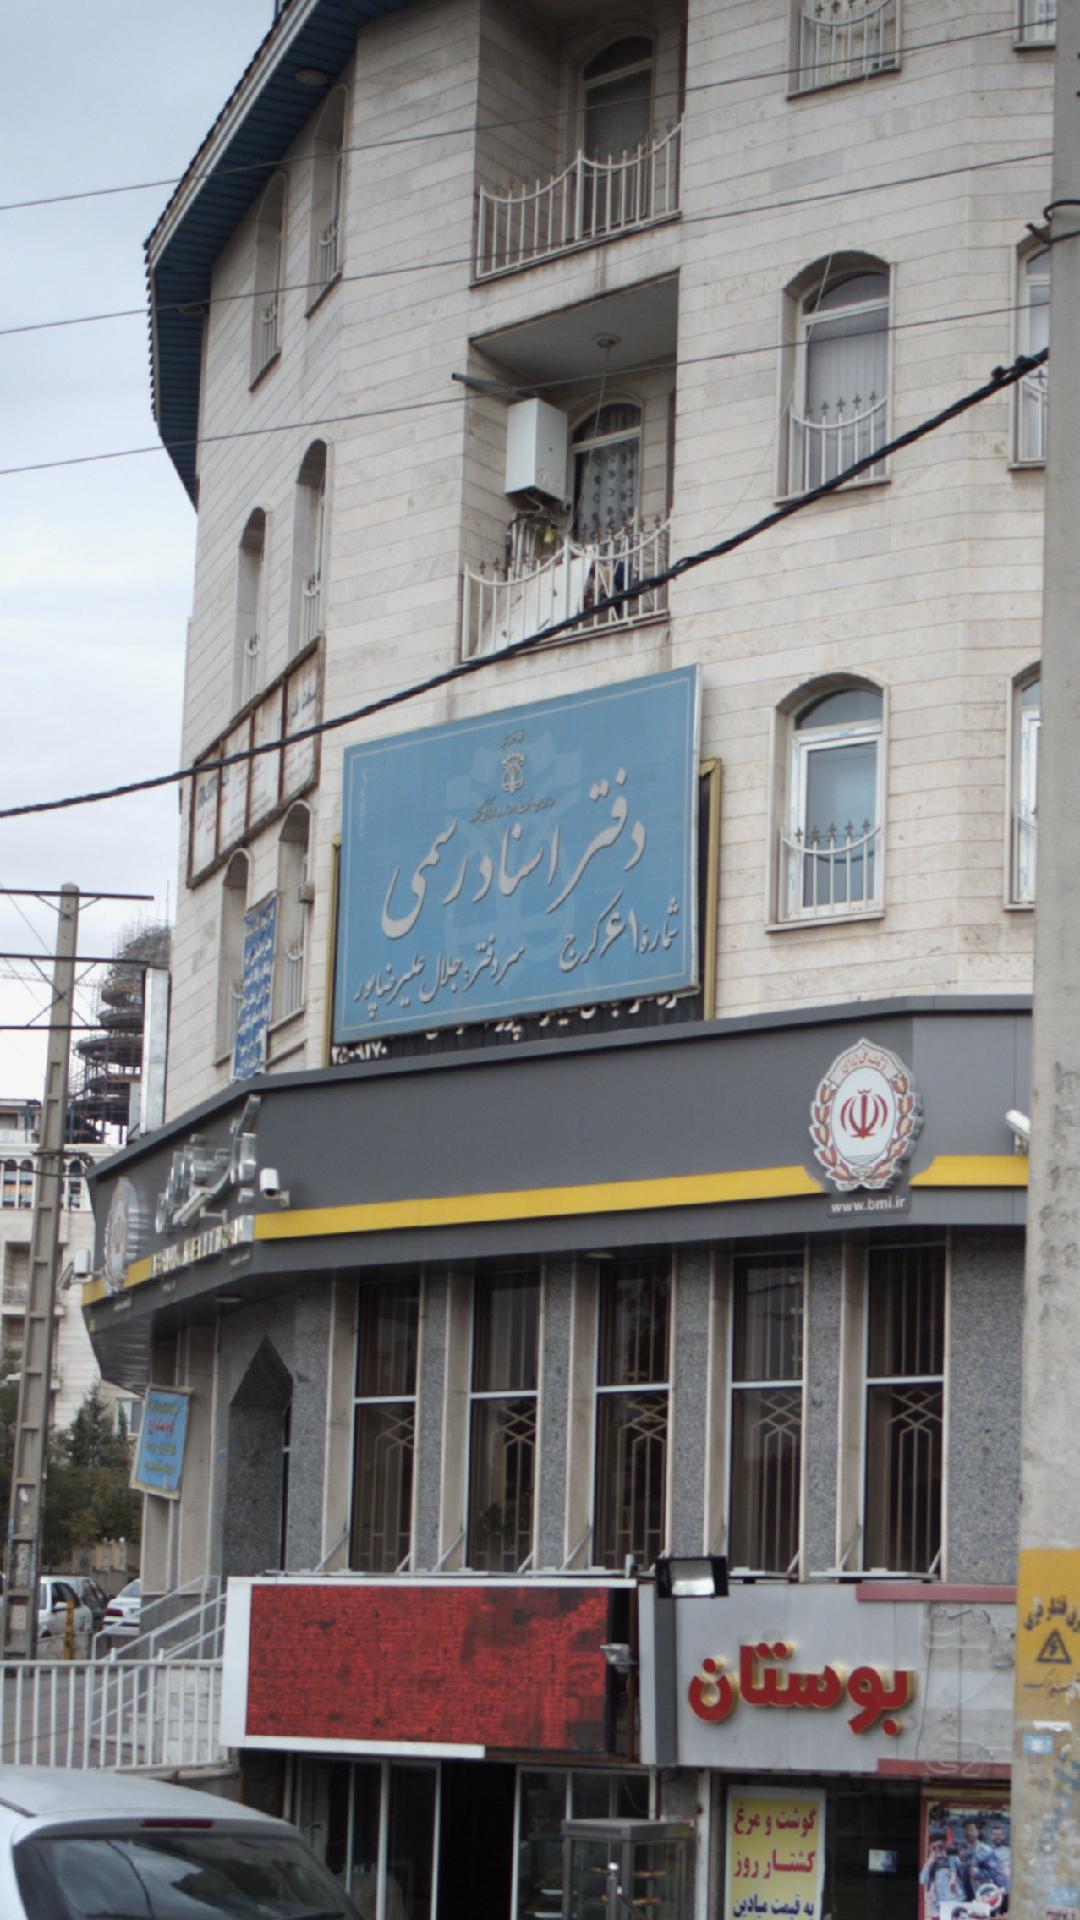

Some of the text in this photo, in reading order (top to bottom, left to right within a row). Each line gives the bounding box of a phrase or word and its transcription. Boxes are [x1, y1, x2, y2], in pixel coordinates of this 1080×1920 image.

[381, 767, 647, 941] دفتر اسناد رسمی
[419, 952, 464, 1004] جلال
[831, 1195, 906, 1213] www.bmi.ir
[687, 1642, 913, 1736] بوستان
[733, 1802, 818, 1838] گوشت و مرغ
[733, 1848, 817, 1880] کشتار روز
